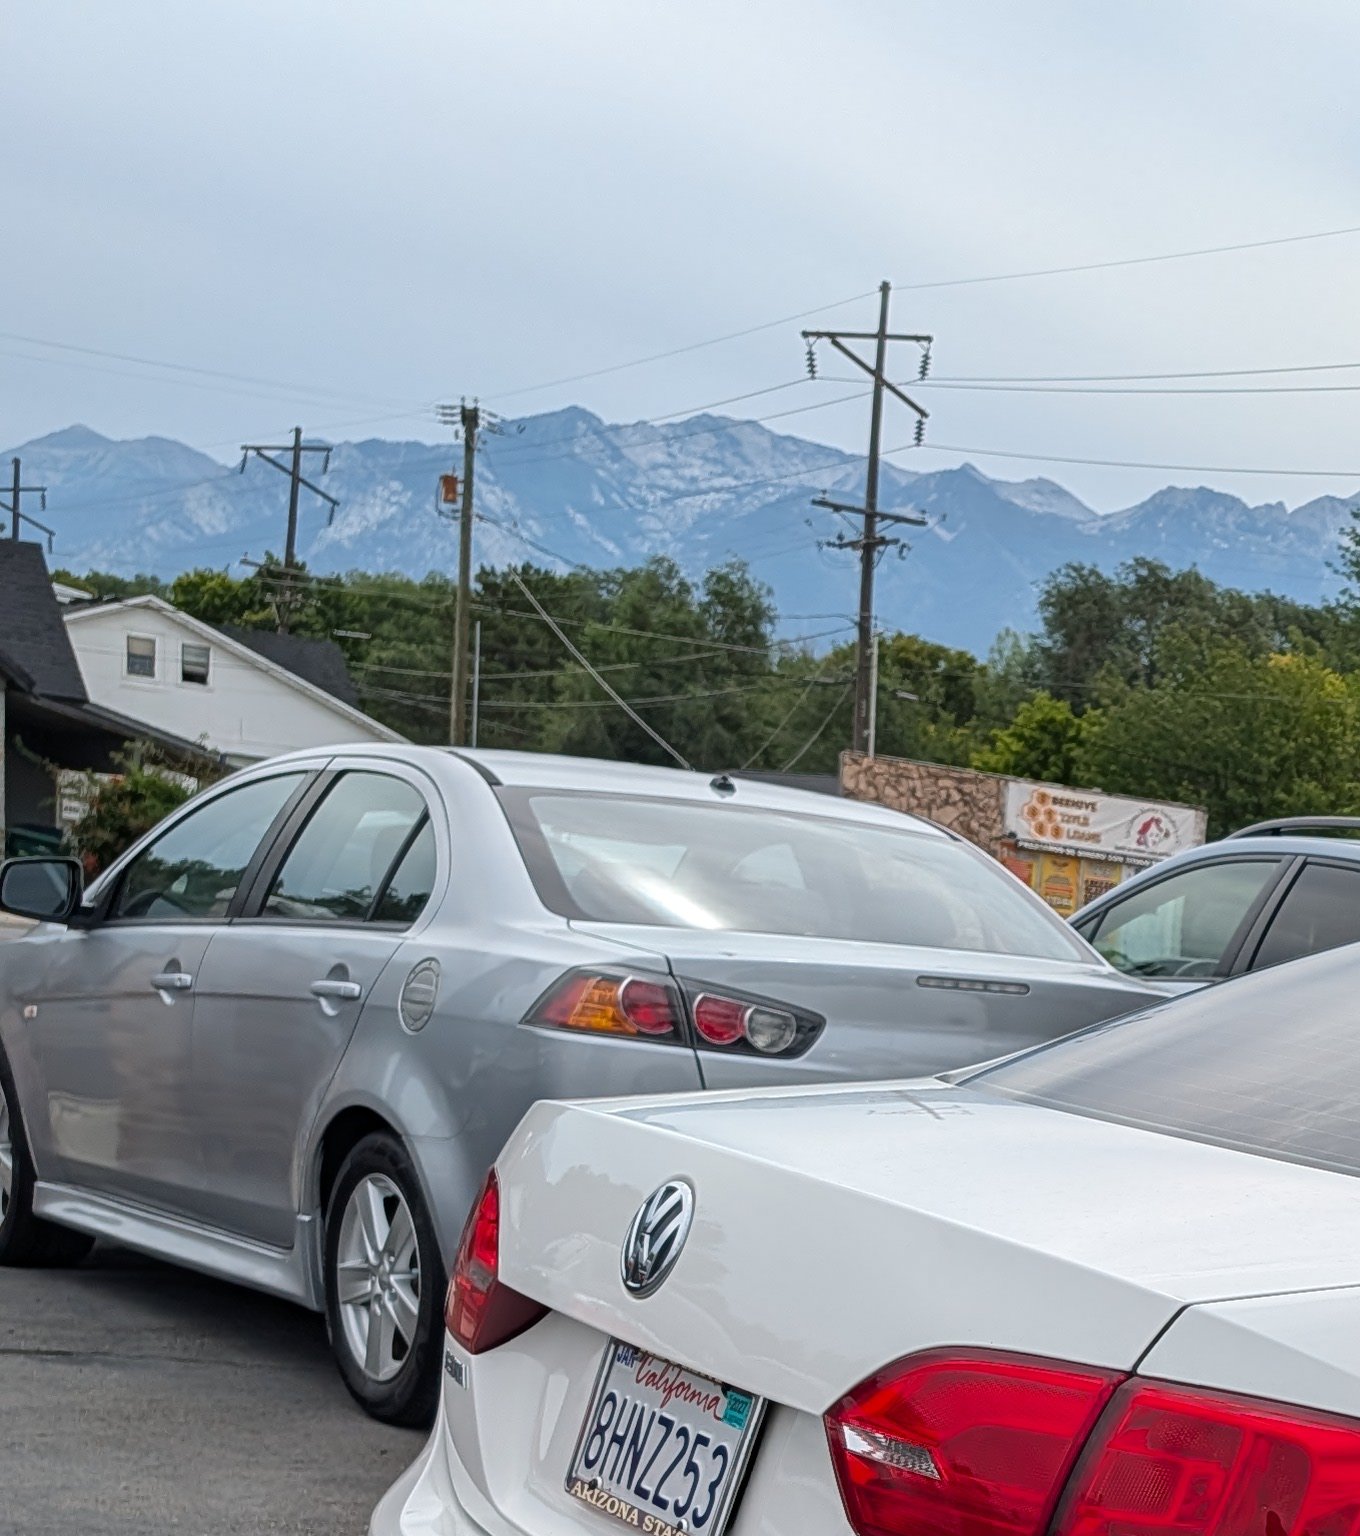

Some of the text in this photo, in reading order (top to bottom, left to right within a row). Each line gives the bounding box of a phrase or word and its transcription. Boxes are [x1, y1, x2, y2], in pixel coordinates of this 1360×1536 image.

[635, 1355, 724, 1421] California
[584, 1391, 728, 1528] 8HNZ253
[571, 1481, 639, 1525] ARIZONA
